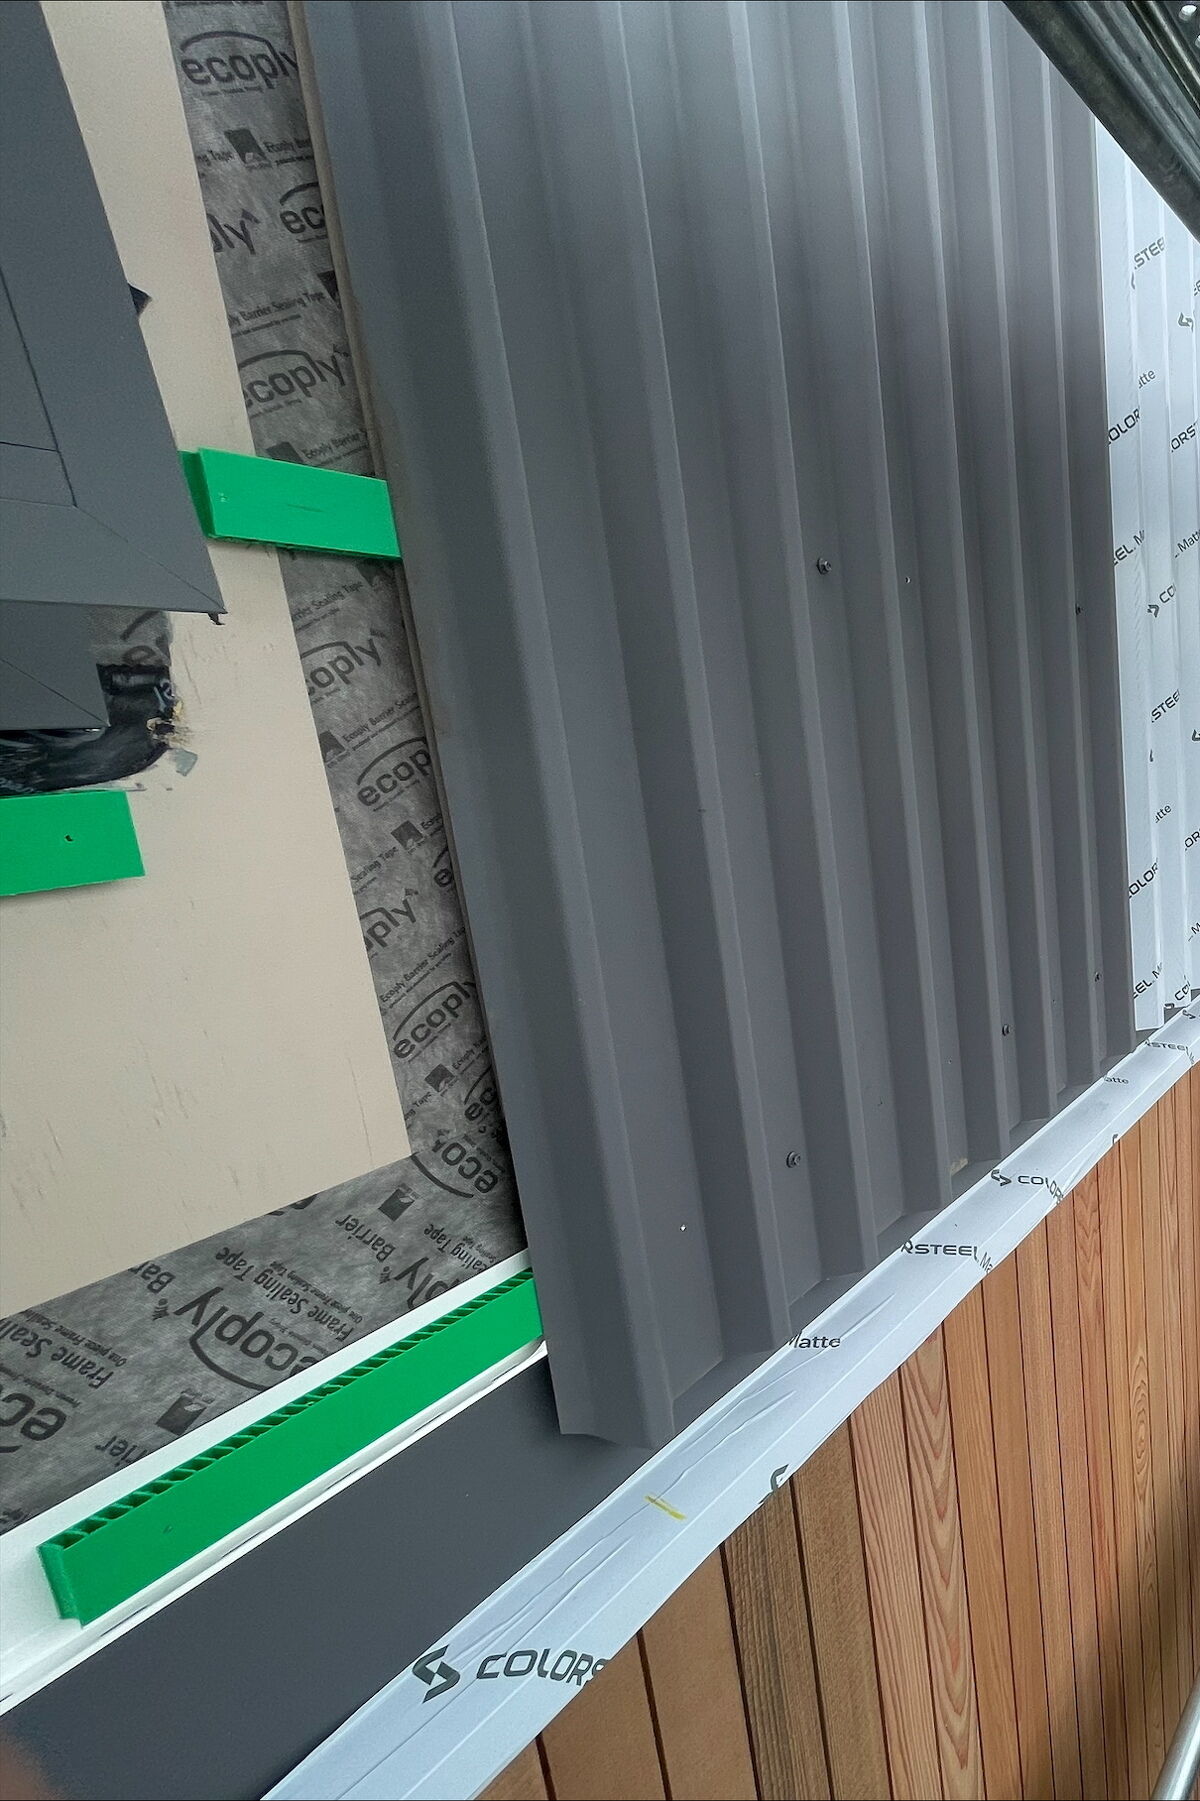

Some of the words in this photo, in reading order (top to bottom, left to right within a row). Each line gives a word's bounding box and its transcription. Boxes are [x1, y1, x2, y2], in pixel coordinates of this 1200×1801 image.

[243, 353, 346, 407] coply
[305, 638, 381, 695] oply
[335, 1213, 397, 1263] Barrier
[422, 1222, 453, 1252] Tape
[214, 1246, 255, 1282] Tape
[253, 1267, 310, 1316] Sealing
[308, 1304, 355, 1342] Frame
[50, 1347, 115, 1390] Frame
